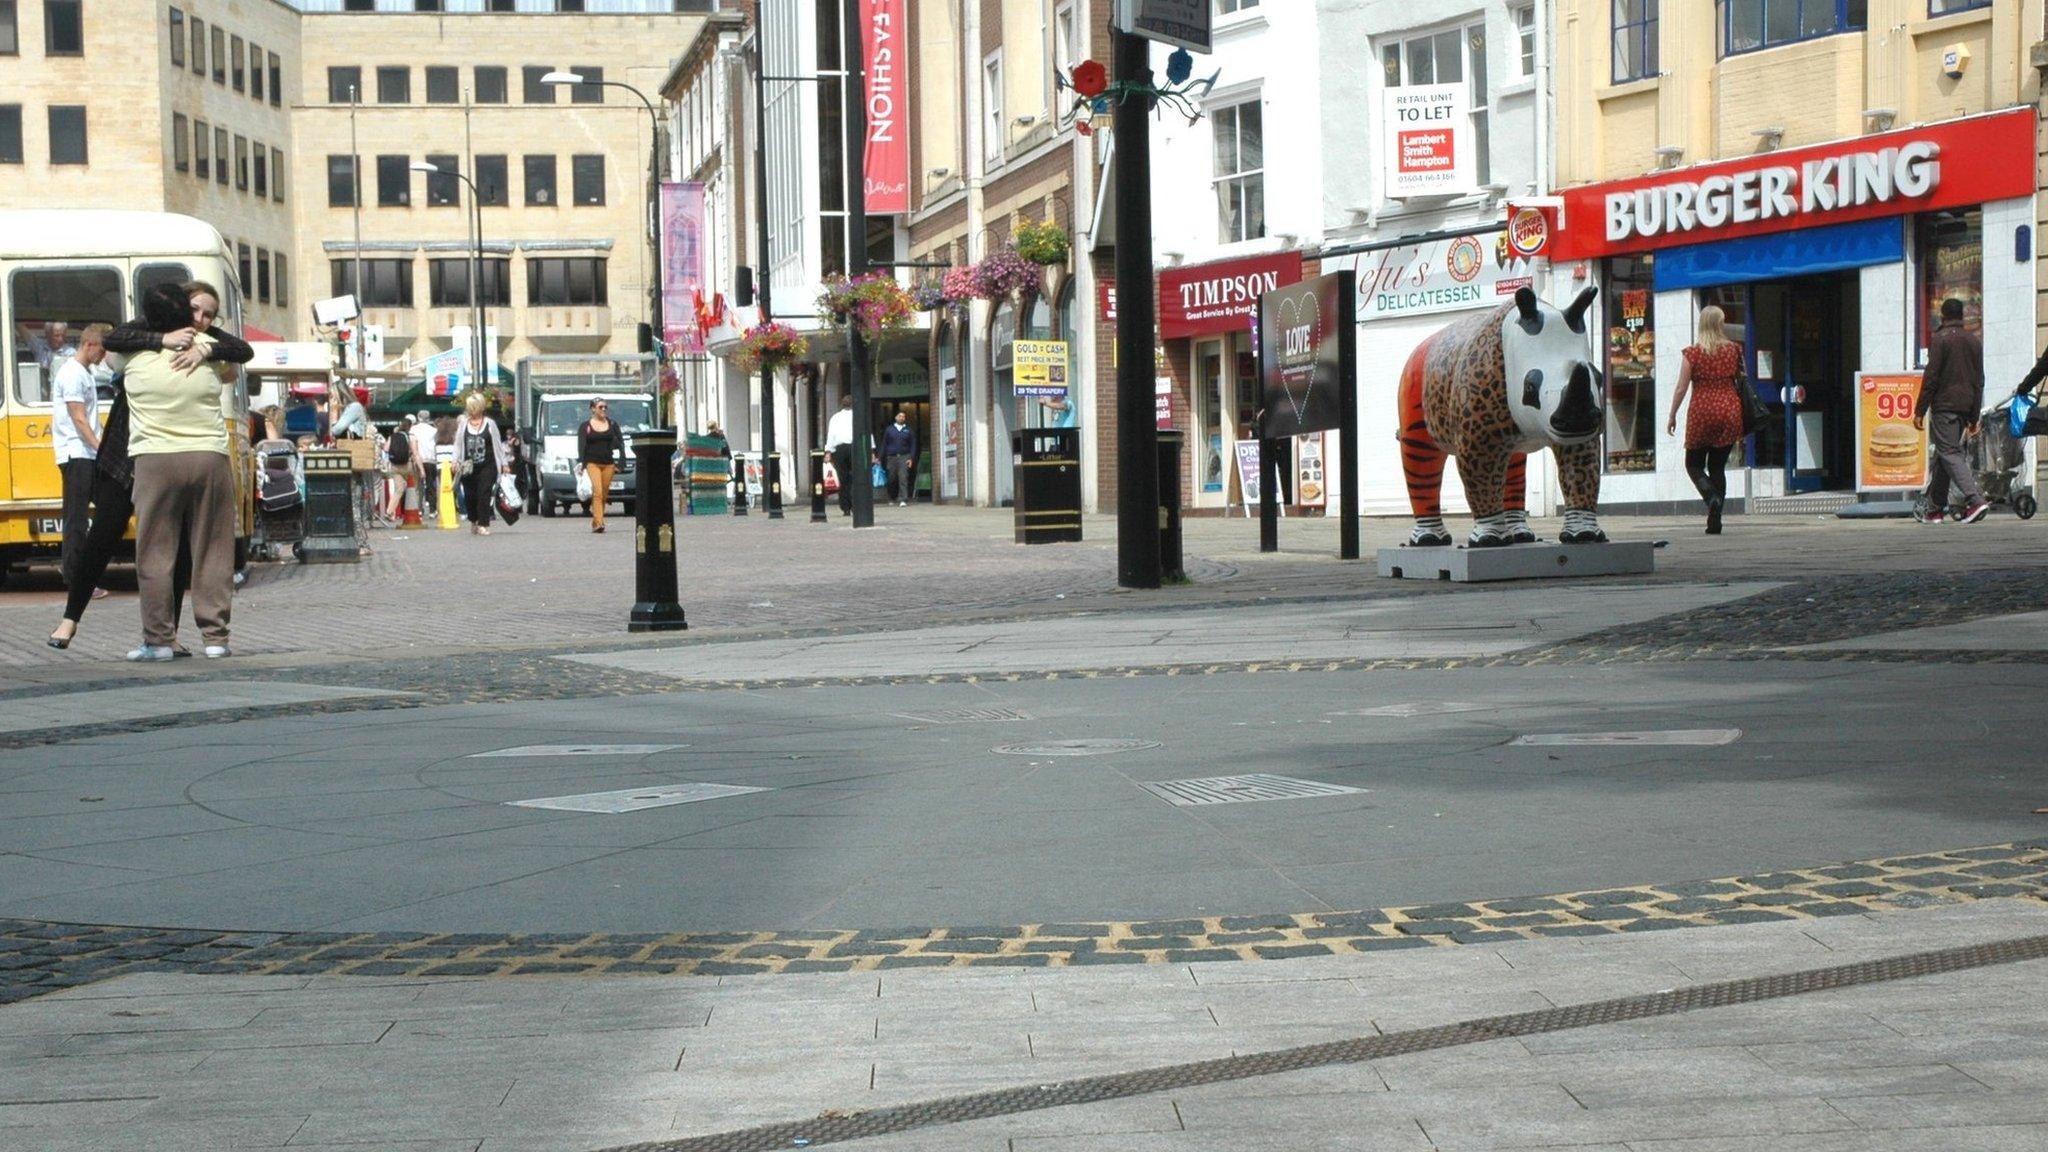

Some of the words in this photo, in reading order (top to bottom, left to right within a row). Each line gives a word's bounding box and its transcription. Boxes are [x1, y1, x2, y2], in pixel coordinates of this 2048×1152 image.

[869, 12, 894, 143] FASHION
[1397, 95, 1428, 104] RETAIL
[1431, 93, 1453, 102] UNIT
[1398, 107, 1420, 121] TO
[1424, 105, 1454, 120] LET
[1403, 133, 1447, 145] Lambert
[1403, 145, 1434, 156] Smith
[1403, 155, 1450, 168] Hampton
[1605, 165, 1798, 241] BURGER
[1801, 141, 1941, 214] KING
[1514, 215, 1542, 232] BURGER
[1515, 224, 1544, 242] KING
[1180, 271, 1278, 309] TIMPSON
[1377, 284, 1481, 311] DELICATESSEN
[1186, 311, 1203, 321] Great
[1203, 309, 1225, 319] Service
[1225, 307, 1233, 317] By
[1234, 305, 1251, 315] Great
[1623, 307, 1646, 319] DAY
[1285, 324, 1311, 357] LOVE
[1017, 344, 1038, 353] GOLD
[1046, 344, 1066, 354] CASH
[1025, 387, 1038, 395] THE
